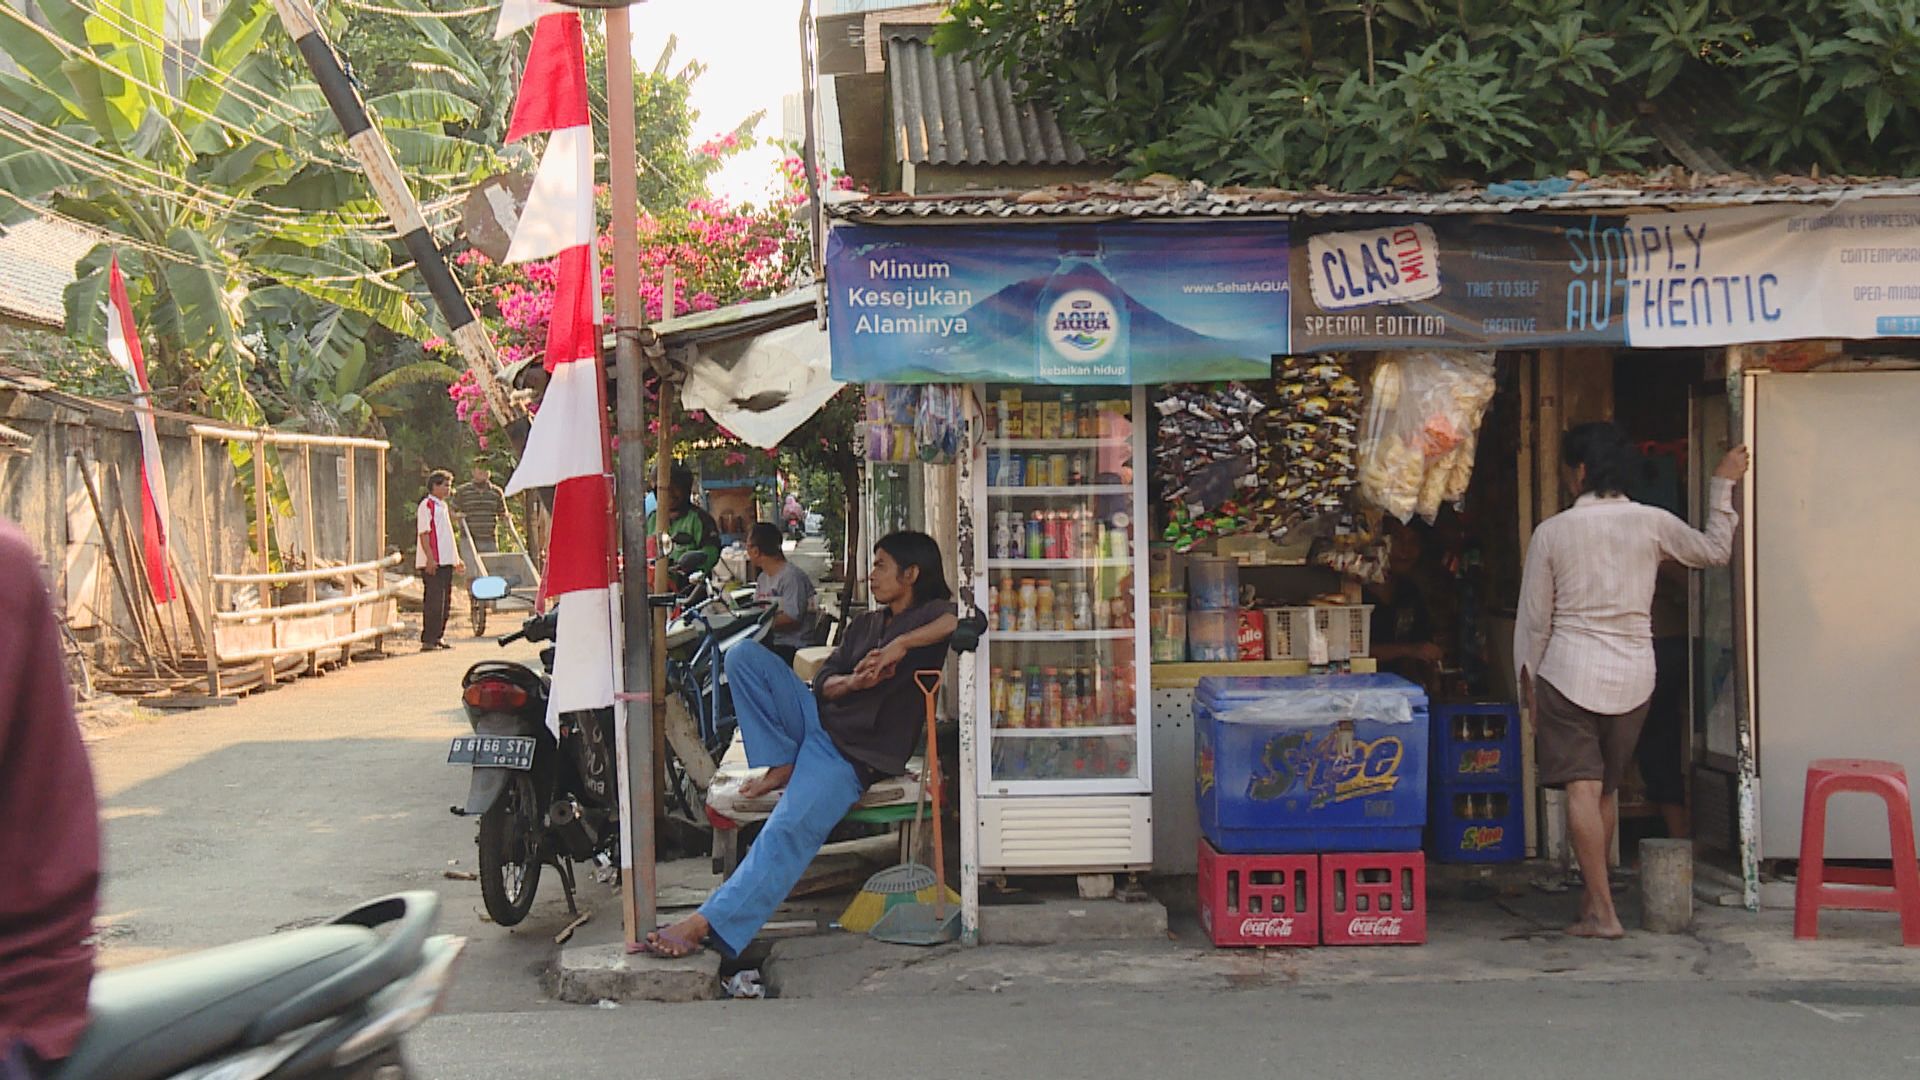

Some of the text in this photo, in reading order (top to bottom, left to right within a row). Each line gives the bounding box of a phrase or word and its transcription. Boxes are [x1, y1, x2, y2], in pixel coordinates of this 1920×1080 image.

[1566, 214, 1706, 274] SIMPLY
[1393, 228, 1429, 283] MILD
[1840, 248, 1920, 263] CONTEMPORA
[869, 259, 950, 279] Minum
[1322, 236, 1399, 300] CLAS
[848, 286, 972, 309] Kesejukan
[1465, 280, 1539, 298] TRUE TO SELF
[1566, 272, 1781, 331] AUTHENTIC
[855, 314, 968, 337] Alaminya
[1053, 311, 1111, 335] AQUA
[1304, 315, 1445, 336] SPECIAL EDITION
[1482, 318, 1536, 335] CREATIVE
[1040, 364, 1126, 376] kebaikan hidup
[1238, 629, 1262, 644] ullo
[453, 740, 462, 751] B
[506, 740, 532, 755] STY
[1240, 918, 1295, 936] Coca-Cola
[1348, 917, 1402, 936] Coca-Cola
